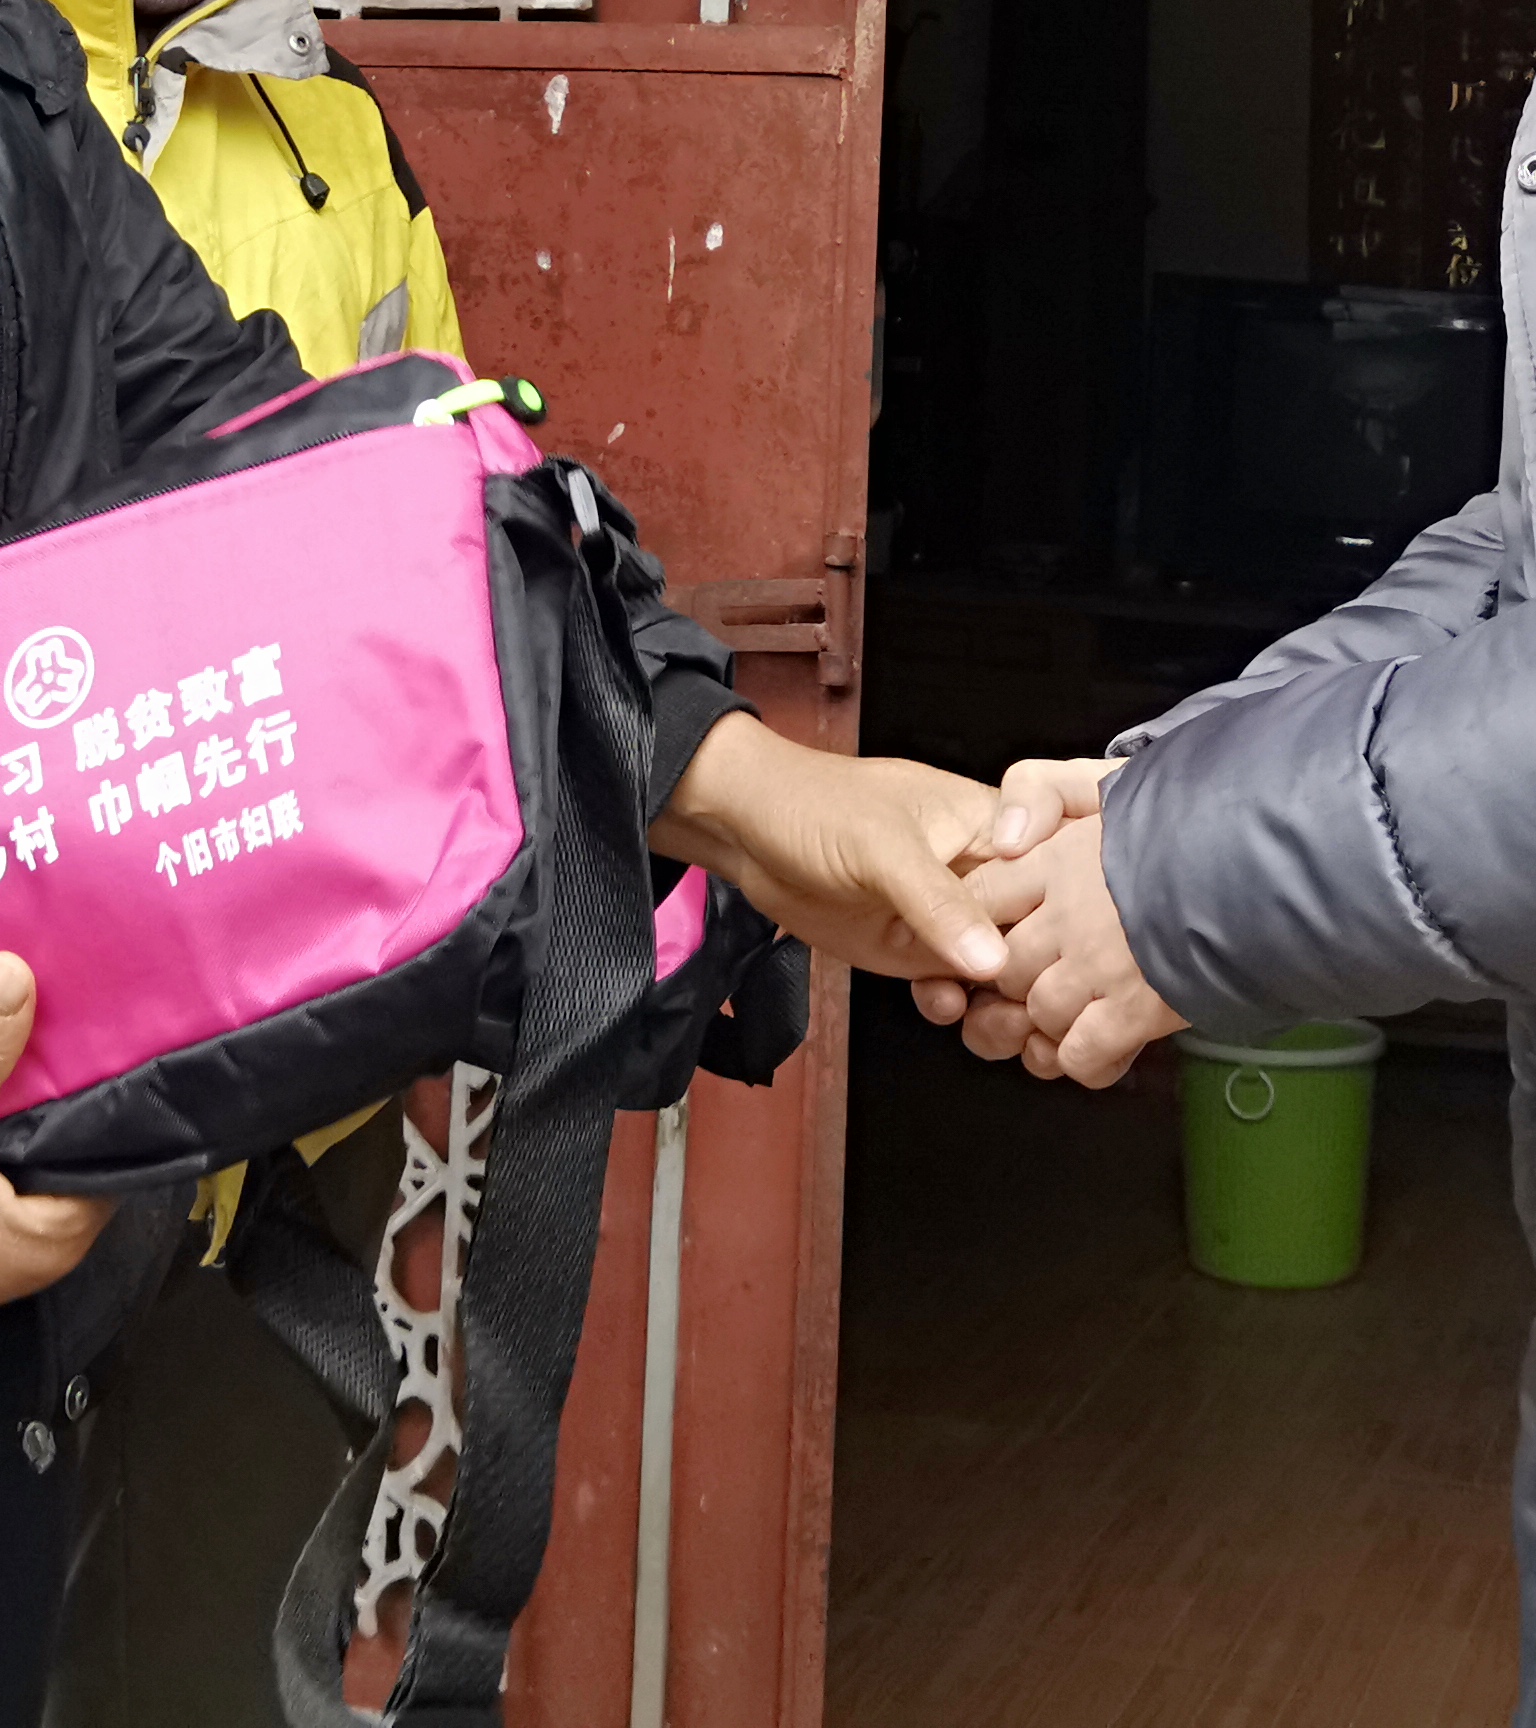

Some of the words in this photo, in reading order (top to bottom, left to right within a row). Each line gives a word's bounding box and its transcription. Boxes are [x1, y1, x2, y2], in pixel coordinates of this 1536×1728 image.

[72, 642, 284, 772] 脱贫致富
[87, 709, 298, 836] 巾帼先行
[155, 789, 305, 887] 个旧市妇联
